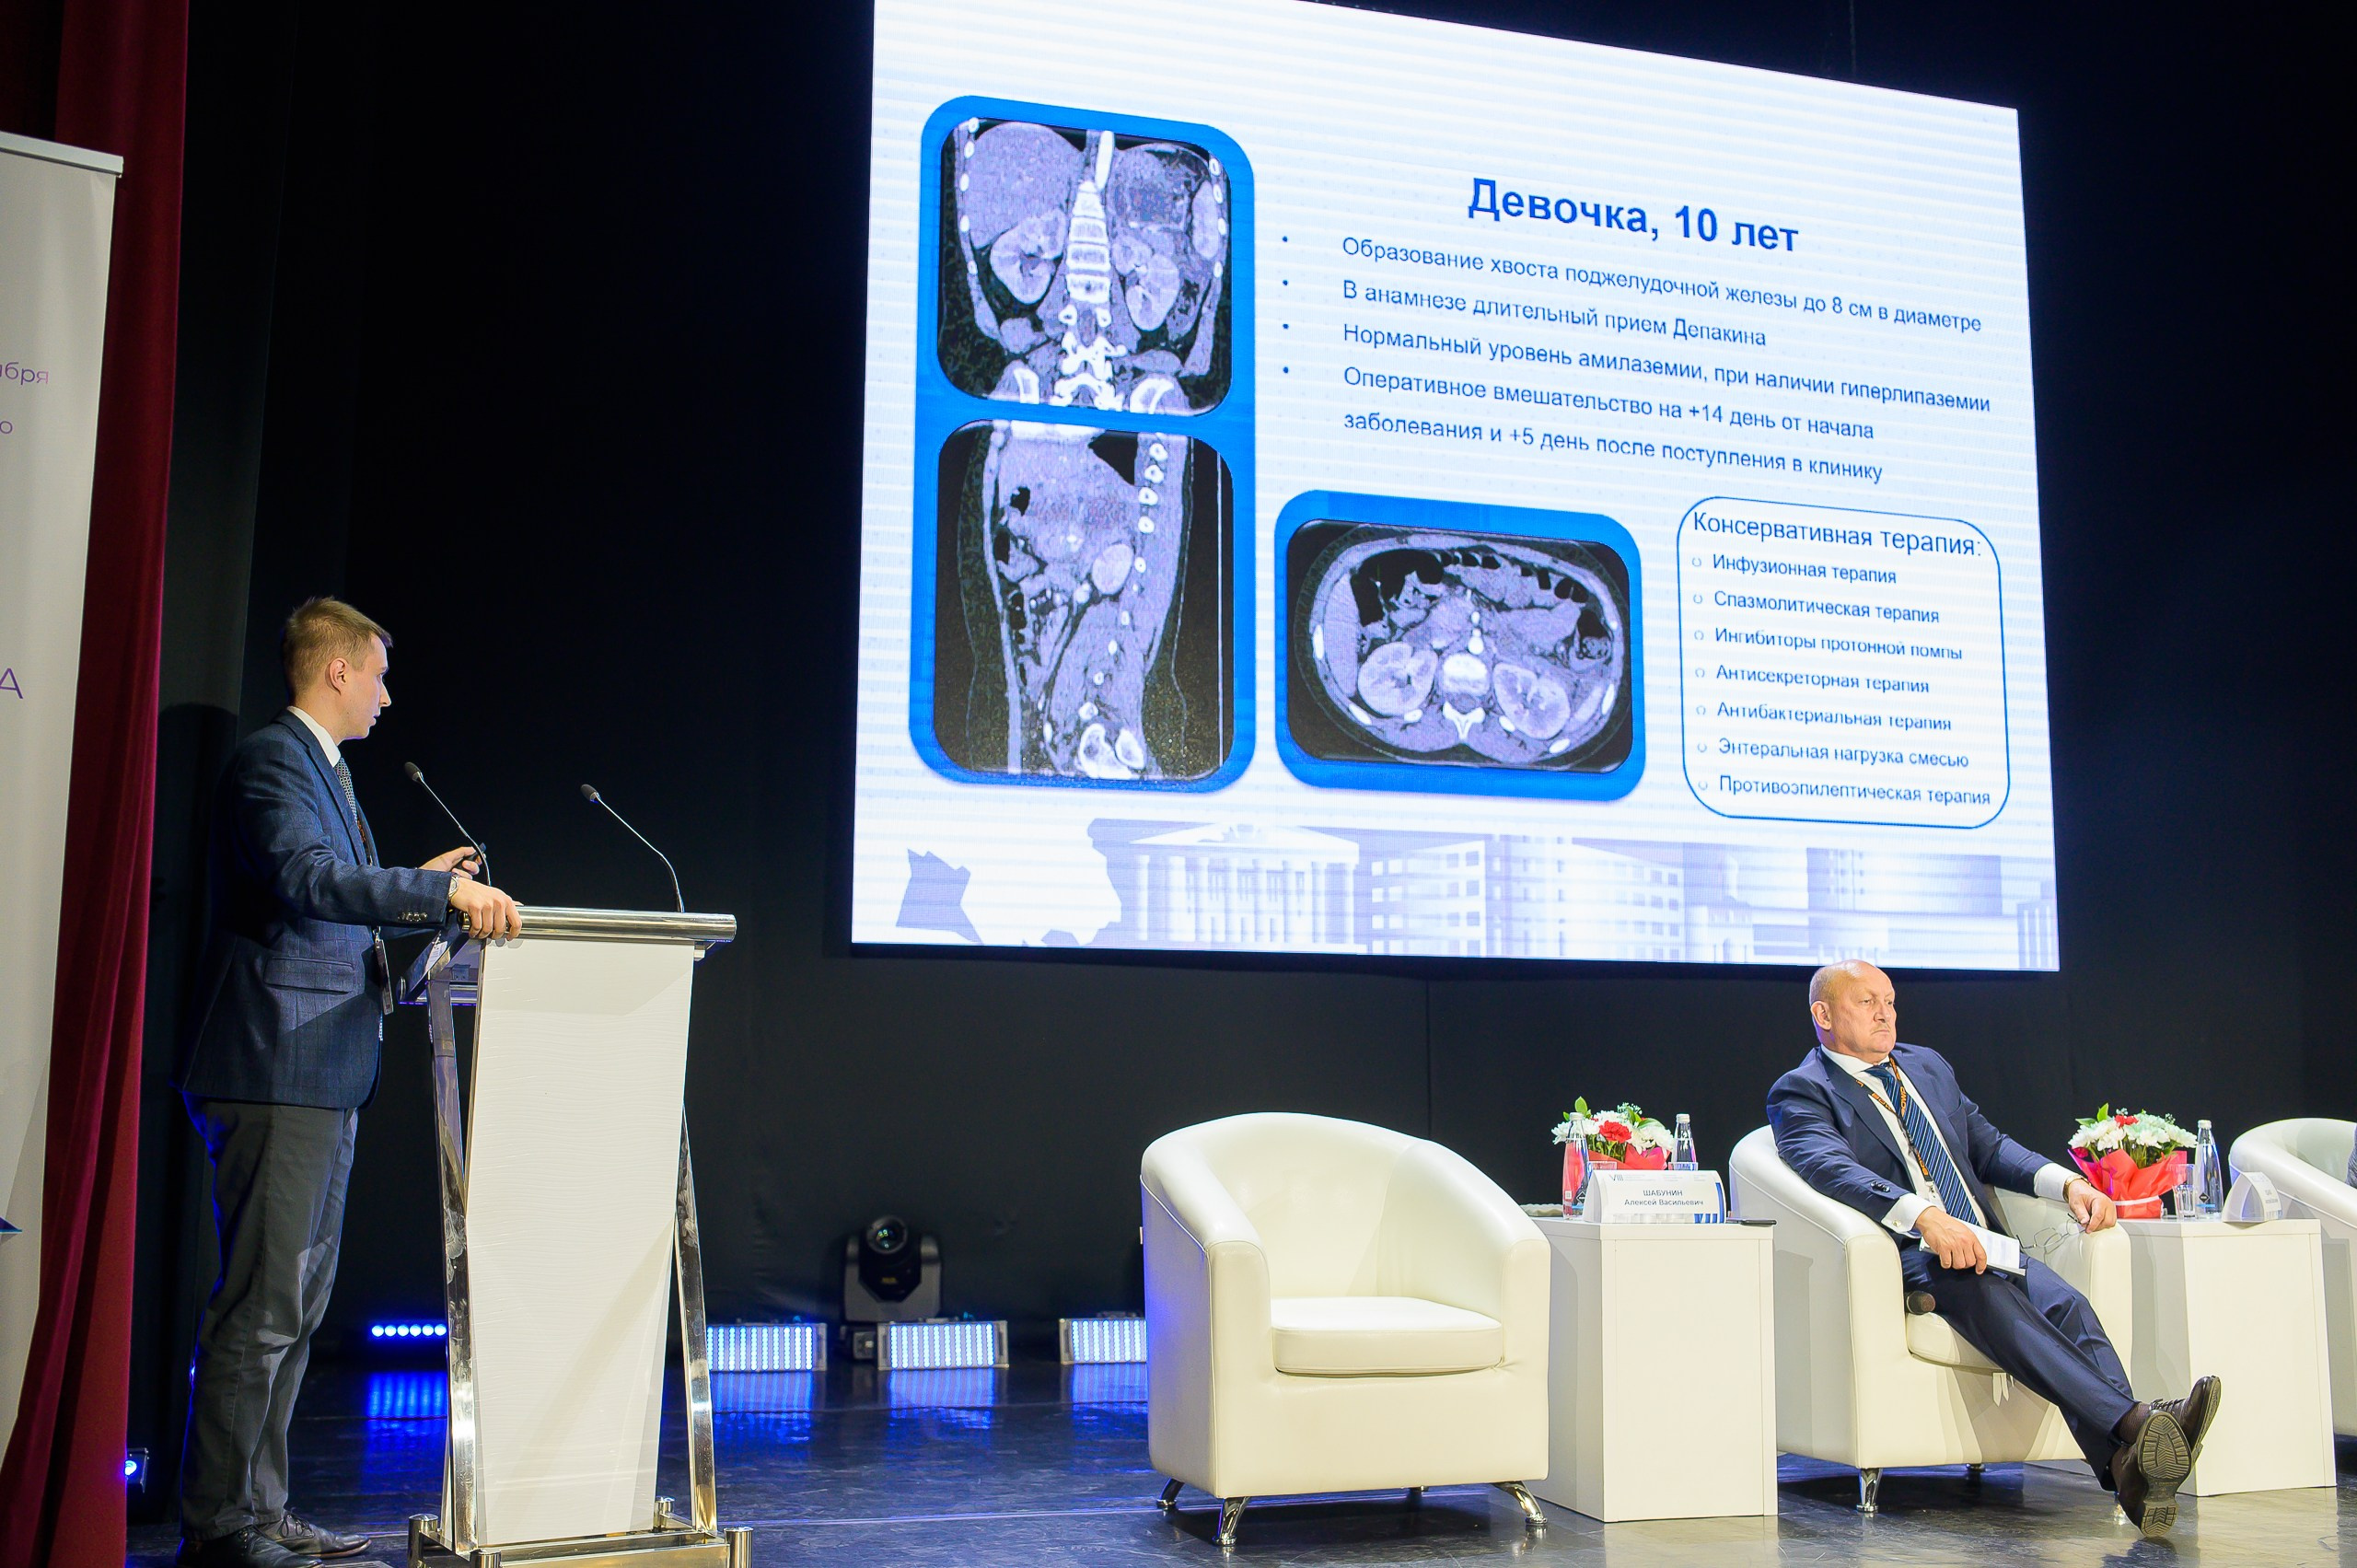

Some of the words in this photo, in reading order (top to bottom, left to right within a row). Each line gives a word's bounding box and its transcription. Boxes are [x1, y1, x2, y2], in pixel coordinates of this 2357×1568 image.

[1467, 178, 1659, 241] Девочка,
[1674, 205, 1719, 241] 10
[1731, 222, 1800, 251] лет
[1342, 237, 1484, 270] Образование
[1491, 259, 1559, 279] хвоста
[1565, 268, 1720, 299] поджелудочной
[1725, 287, 1797, 308] железы
[1803, 297, 1827, 313] до
[1831, 296, 1843, 314] 8
[1848, 303, 1873, 318] см
[1877, 307, 1889, 319] в
[1893, 309, 1982, 333] диаметре
[1342, 280, 1358, 299] В
[1364, 287, 1467, 311] анамнезе
[1472, 300, 1598, 326] длительный
[1605, 315, 1667, 334] прием
[1672, 318, 1767, 345] Депакина
[0, 361, 49, 386] бря
[1343, 324, 1481, 354] Нормальный
[1488, 343, 1573, 365] уровень
[1578, 354, 1708, 382] амилаземии,
[1714, 368, 1748, 387] при
[1755, 373, 1835, 394] наличии
[1840, 383, 1991, 412] гиперлипаземии
[1343, 366, 1487, 398] Оперативное
[1493, 386, 1653, 414] вмешательство
[1658, 403, 1682, 418] на
[1689, 404, 1724, 423] +14
[1729, 412, 1776, 428] день
[1782, 416, 1802, 430] от
[1807, 420, 1875, 438] начала
[1343, 412, 1483, 440] заболевания
[1490, 428, 1503, 442] и
[1510, 427, 1535, 445] +5
[1539, 433, 1590, 451] день
[1596, 438, 1655, 457] после
[1661, 445, 1786, 470] поступления
[1792, 459, 1803, 471] в
[1808, 460, 1883, 484] клинику
[1693, 512, 1873, 546] Консервативная
[1880, 531, 1981, 556] терапия:
[1713, 554, 1827, 577] Инфузионная
[1831, 567, 1897, 584] терапия
[1713, 591, 1871, 617] Спазмолитическая
[1875, 607, 1940, 622] терапия
[1715, 627, 1817, 650] Ингибиторы
[1820, 639, 1906, 655] протонной
[1910, 645, 1963, 659] помпы
[1715, 665, 1860, 689] Антисекреторная
[1865, 679, 1930, 692] терапия
[1716, 702, 1883, 726] Антибактериальная
[1888, 716, 1952, 731] терапия
[1718, 738, 1829, 760] Энтеральная
[1834, 749, 1904, 765] нагрузка
[1909, 753, 1969, 767] смесью
[1719, 774, 1922, 801] Противоэпилептическая
[1926, 790, 1991, 806] терапия
[1624, 1198, 1657, 1206] Алексей
